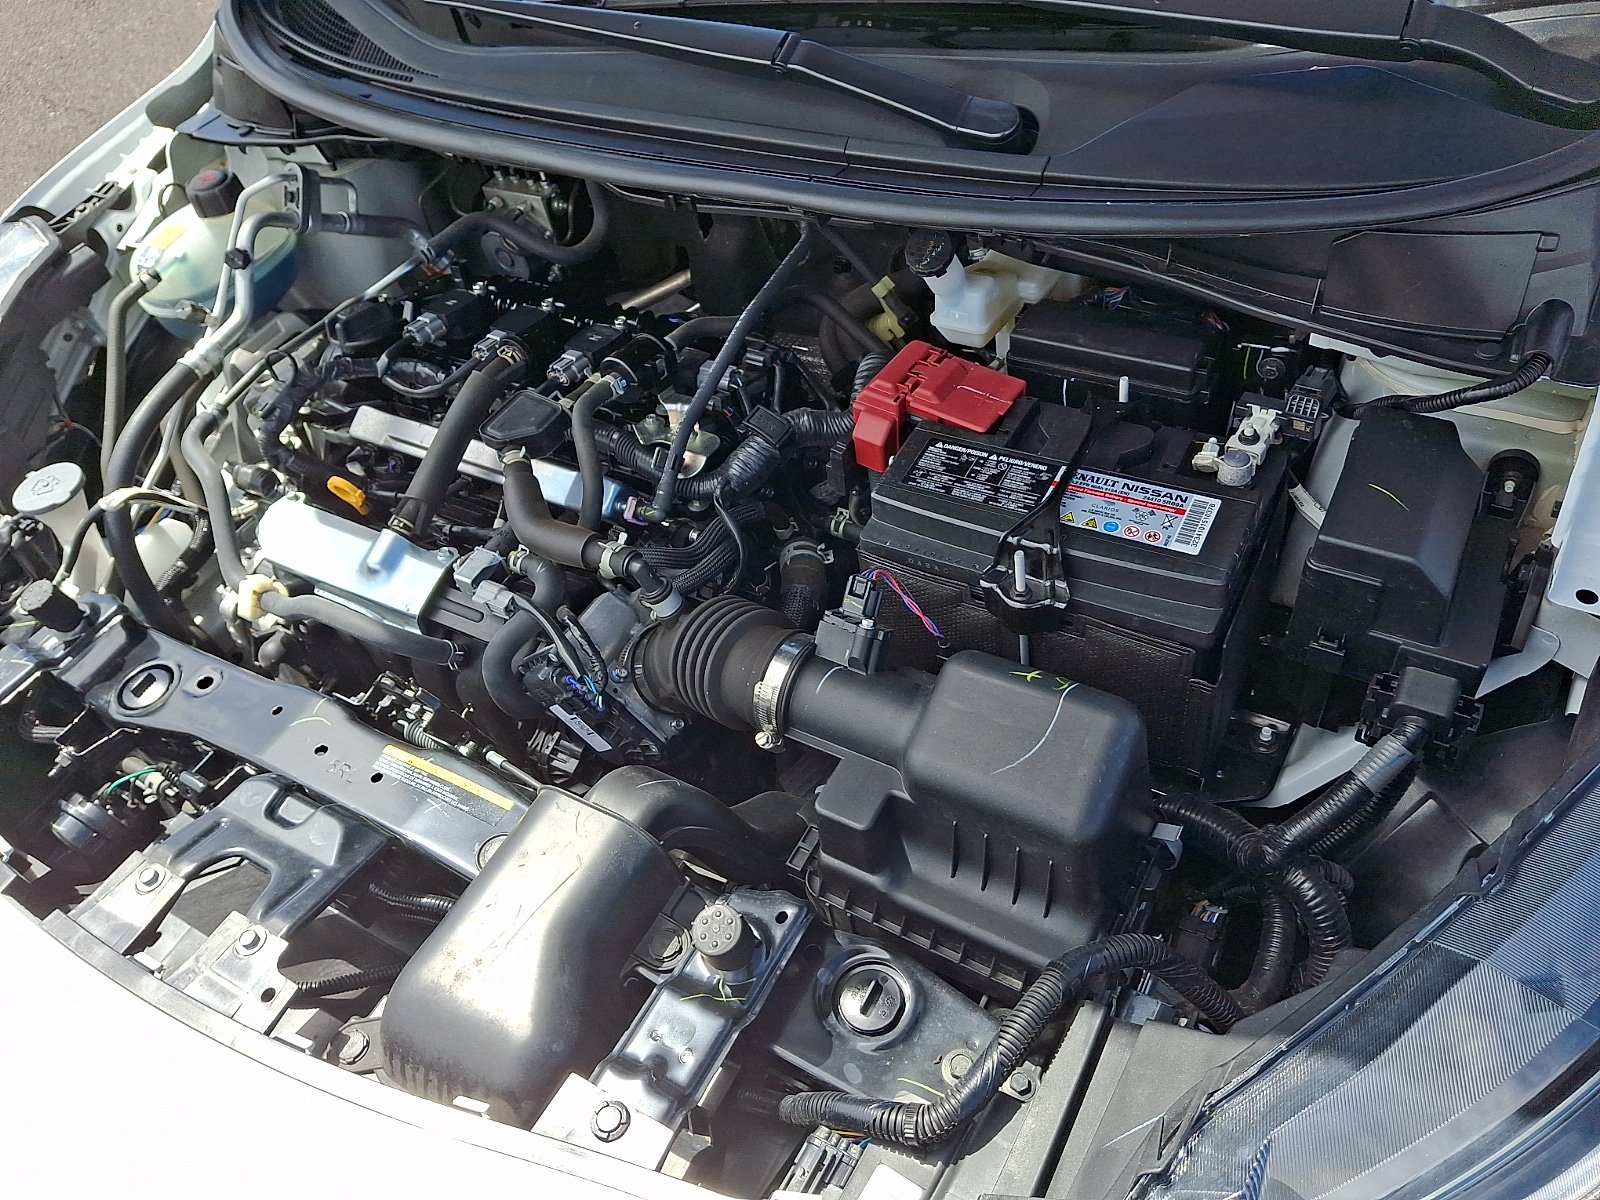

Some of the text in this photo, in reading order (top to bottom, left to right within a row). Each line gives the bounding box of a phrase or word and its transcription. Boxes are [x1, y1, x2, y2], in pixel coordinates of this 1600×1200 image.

[1075, 472, 1189, 504] ENAULT NISSAN
[1091, 503, 1120, 513] CLARIOS
